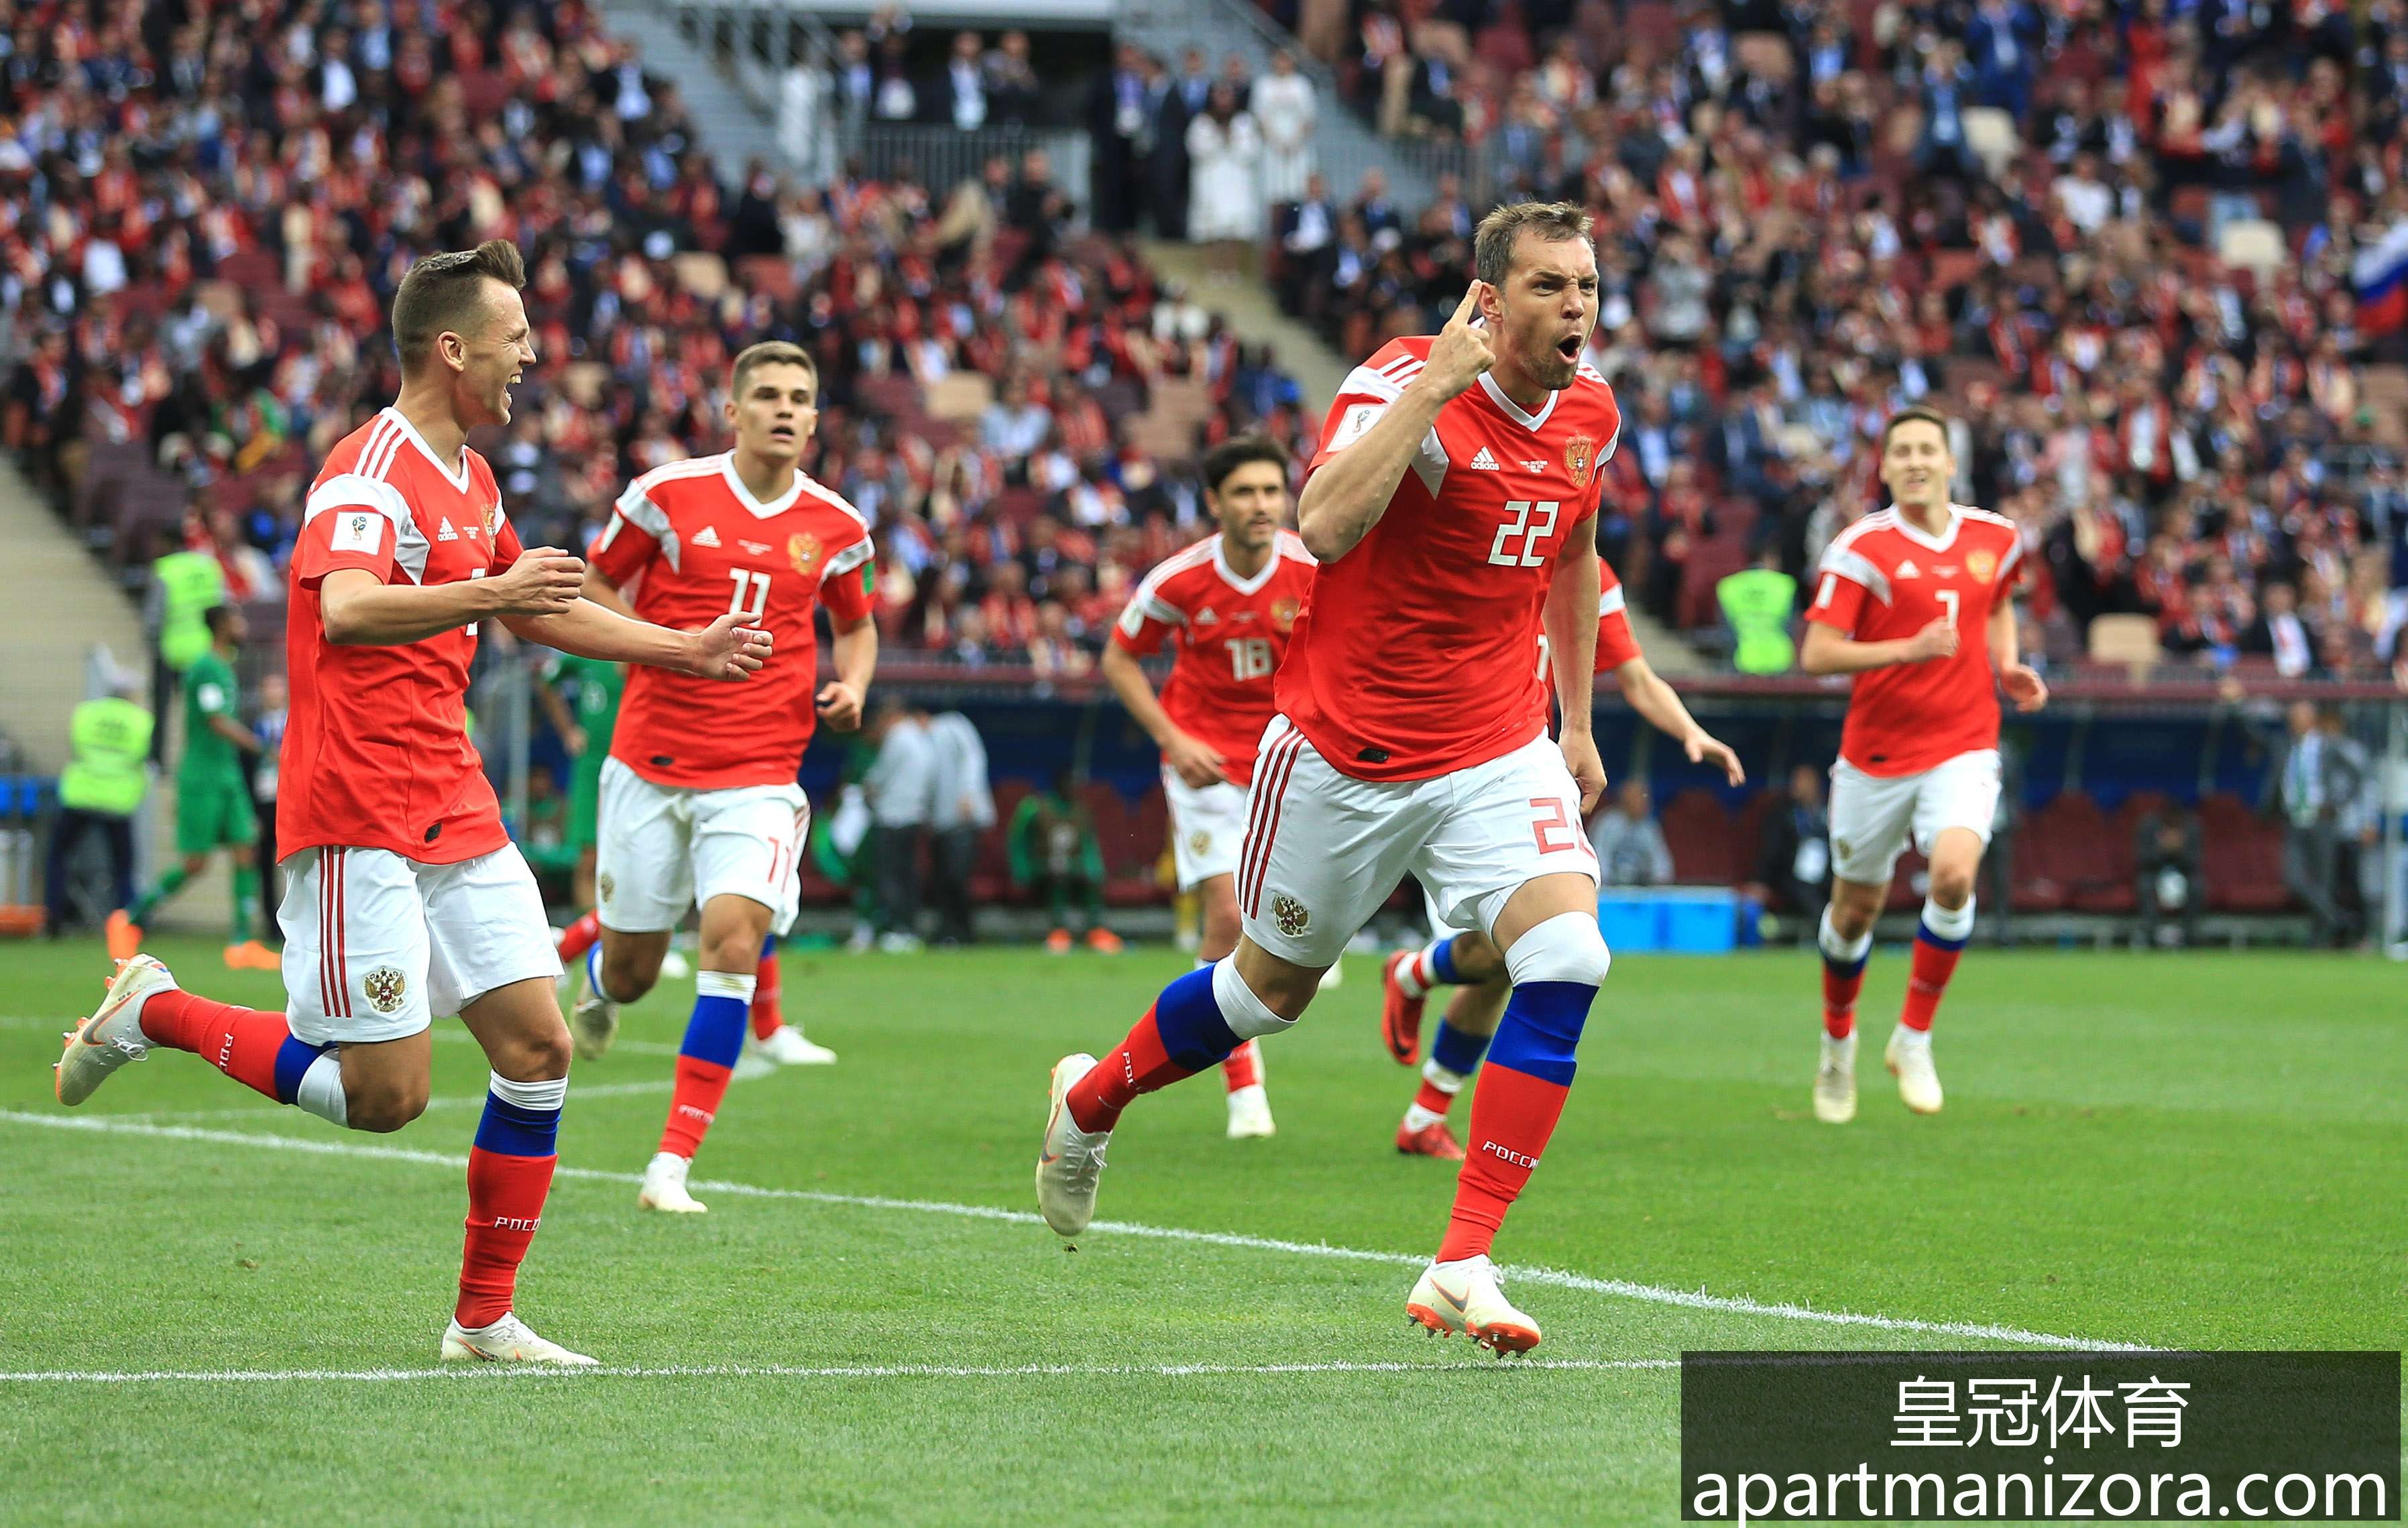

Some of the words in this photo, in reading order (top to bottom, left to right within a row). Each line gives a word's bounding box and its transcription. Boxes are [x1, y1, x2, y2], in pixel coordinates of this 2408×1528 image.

[1471, 460, 1500, 471] adidas
[1488, 500, 1560, 567] 22
[729, 567, 772, 628] 11
